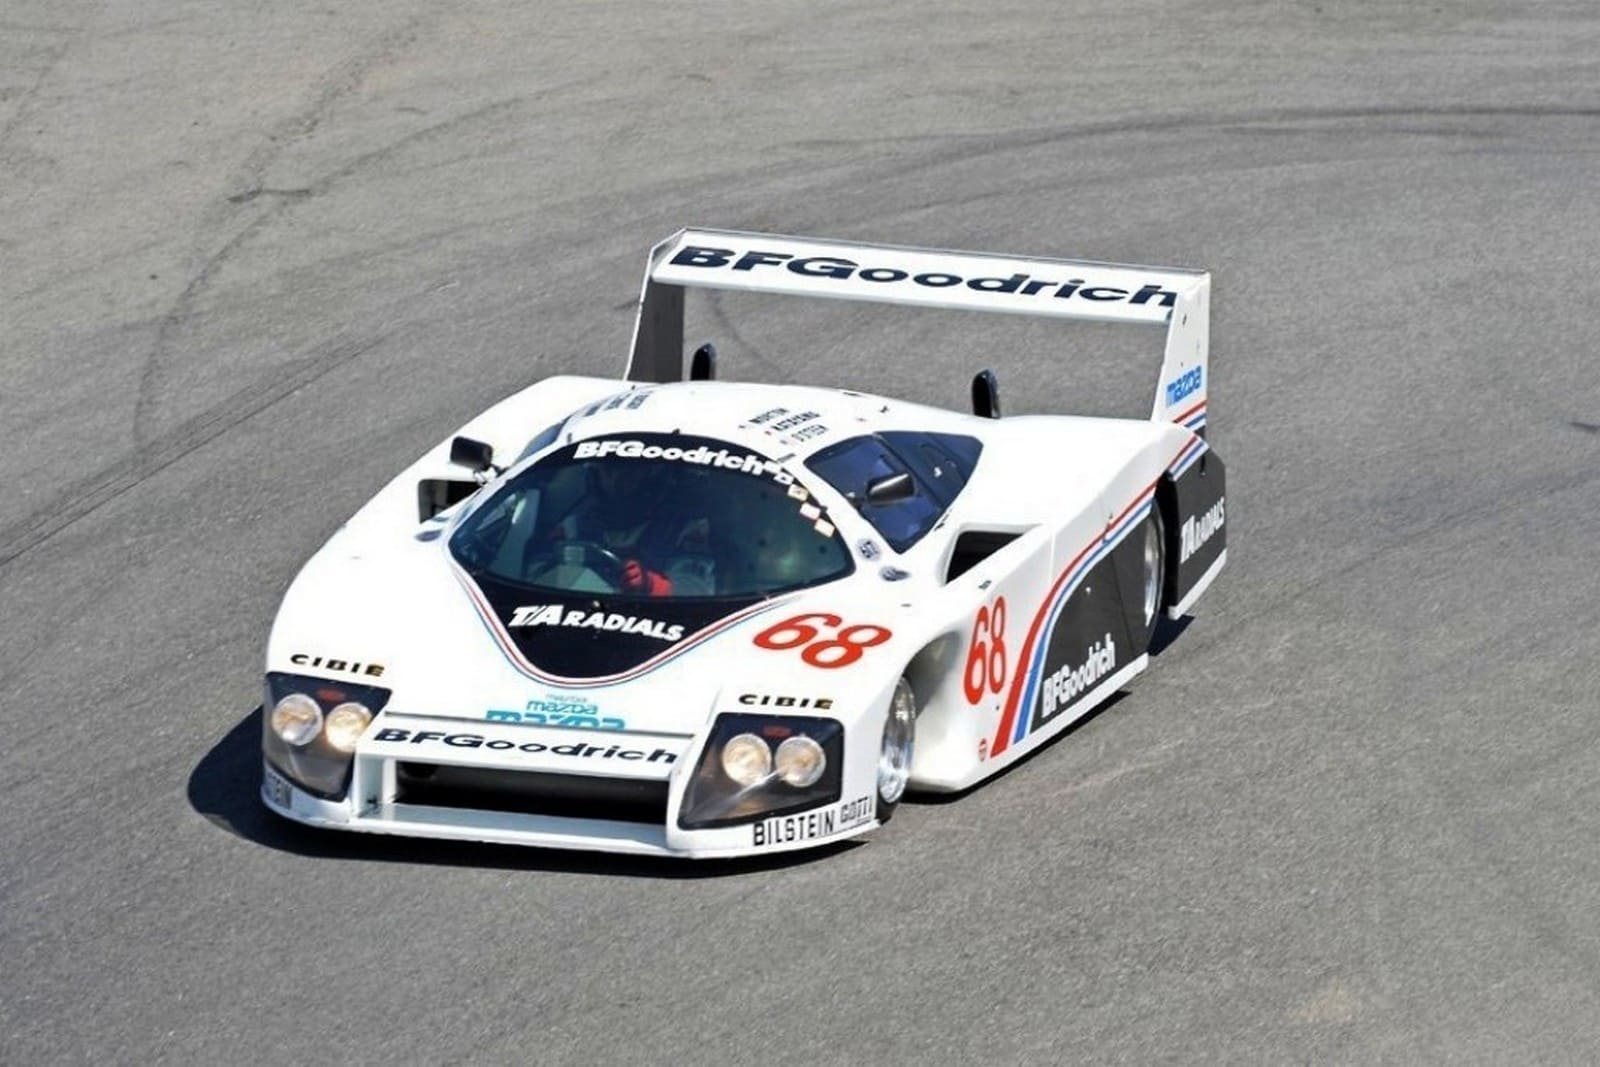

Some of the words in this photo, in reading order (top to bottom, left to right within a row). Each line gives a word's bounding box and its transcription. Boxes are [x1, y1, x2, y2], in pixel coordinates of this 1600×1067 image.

[669, 245, 1178, 307] BFGoodrich
[573, 440, 765, 475] BFGoodrich
[561, 611, 686, 642] RADIALS
[752, 612, 892, 669] 68
[290, 654, 385, 677] CIBIE
[963, 596, 1006, 705] 68
[1041, 632, 1116, 718] BFGoodrich
[526, 700, 598, 715] mazda
[738, 694, 833, 709] CIBIE
[373, 728, 679, 764] BFGoodrich
[753, 810, 836, 846] BILSTEIN
